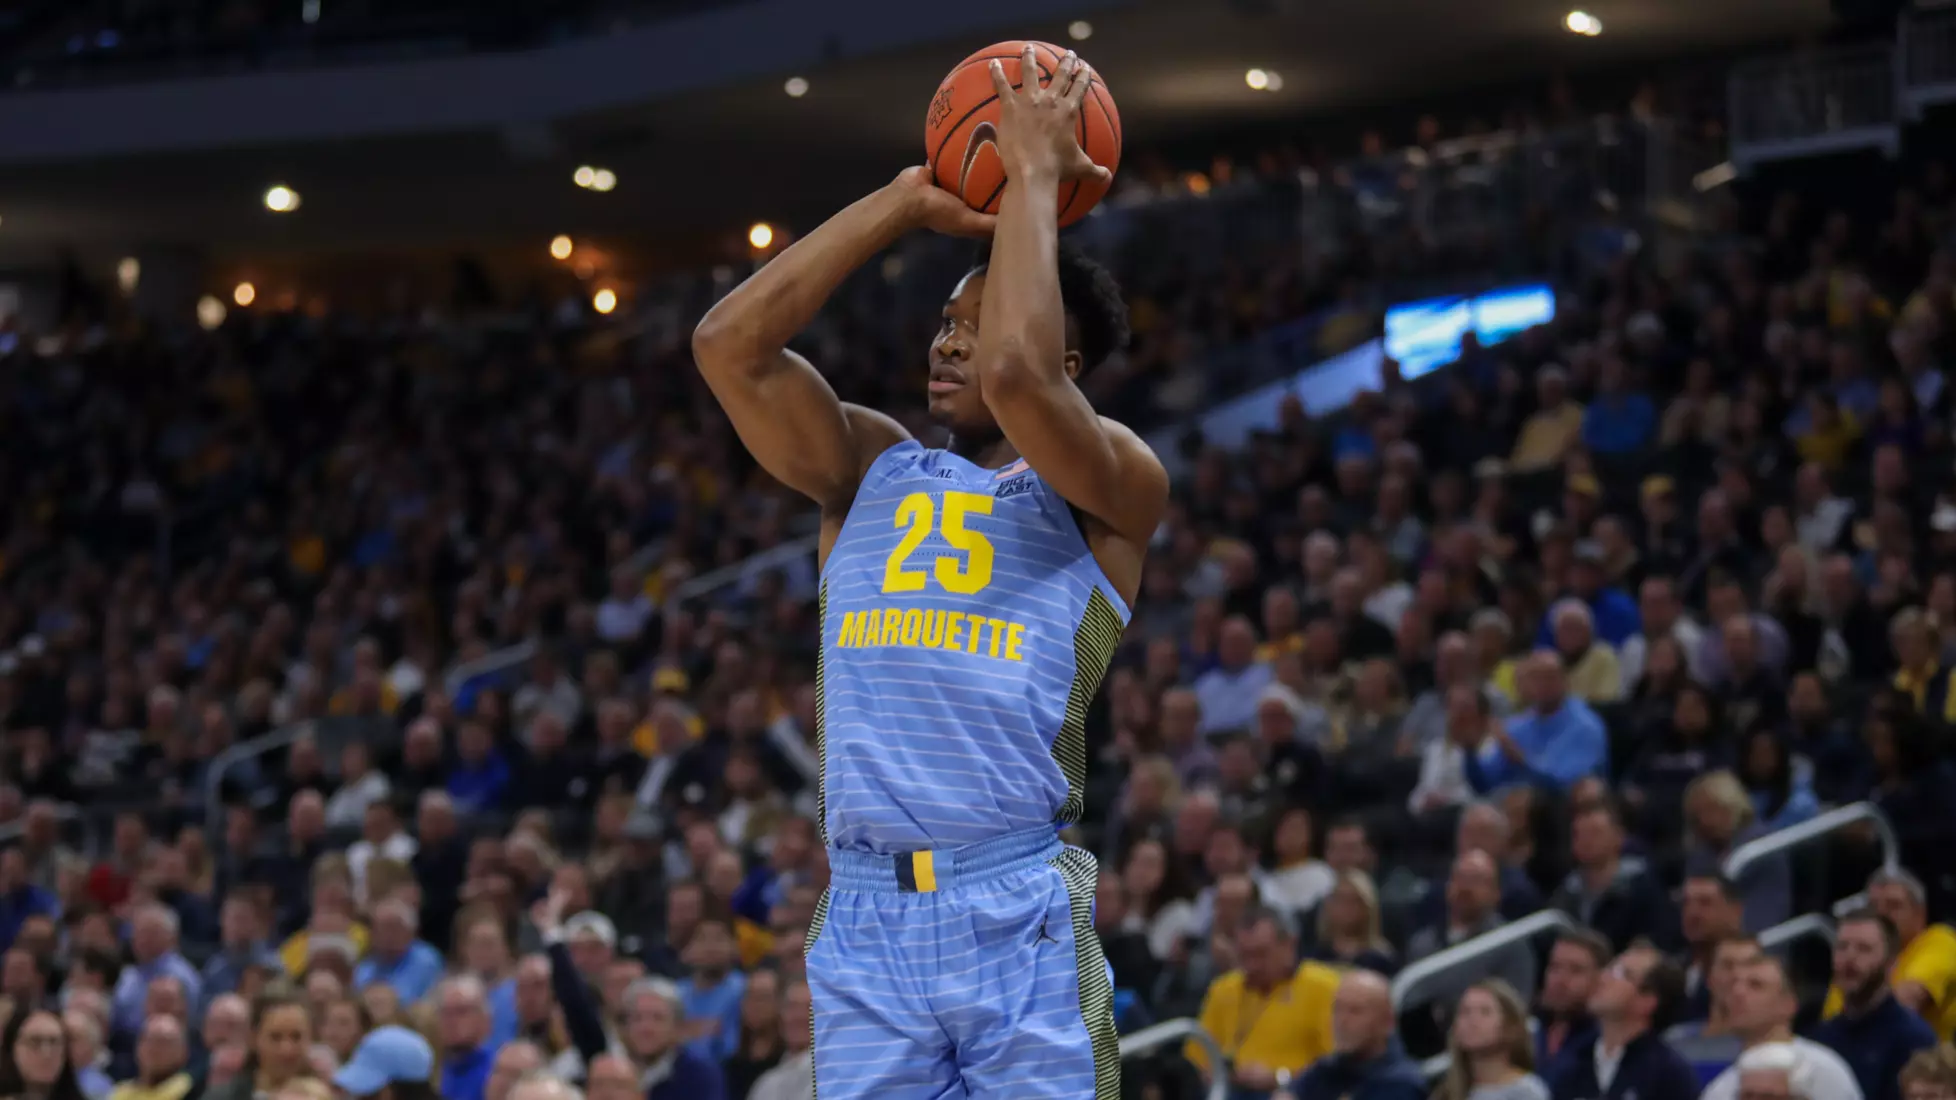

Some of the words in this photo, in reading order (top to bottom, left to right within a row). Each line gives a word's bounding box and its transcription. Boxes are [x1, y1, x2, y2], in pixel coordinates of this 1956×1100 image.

[995, 482, 1034, 498] EAST
[999, 476, 1025, 490] BIG
[882, 490, 994, 595] 25
[837, 608, 1025, 661] MARQUETTE
